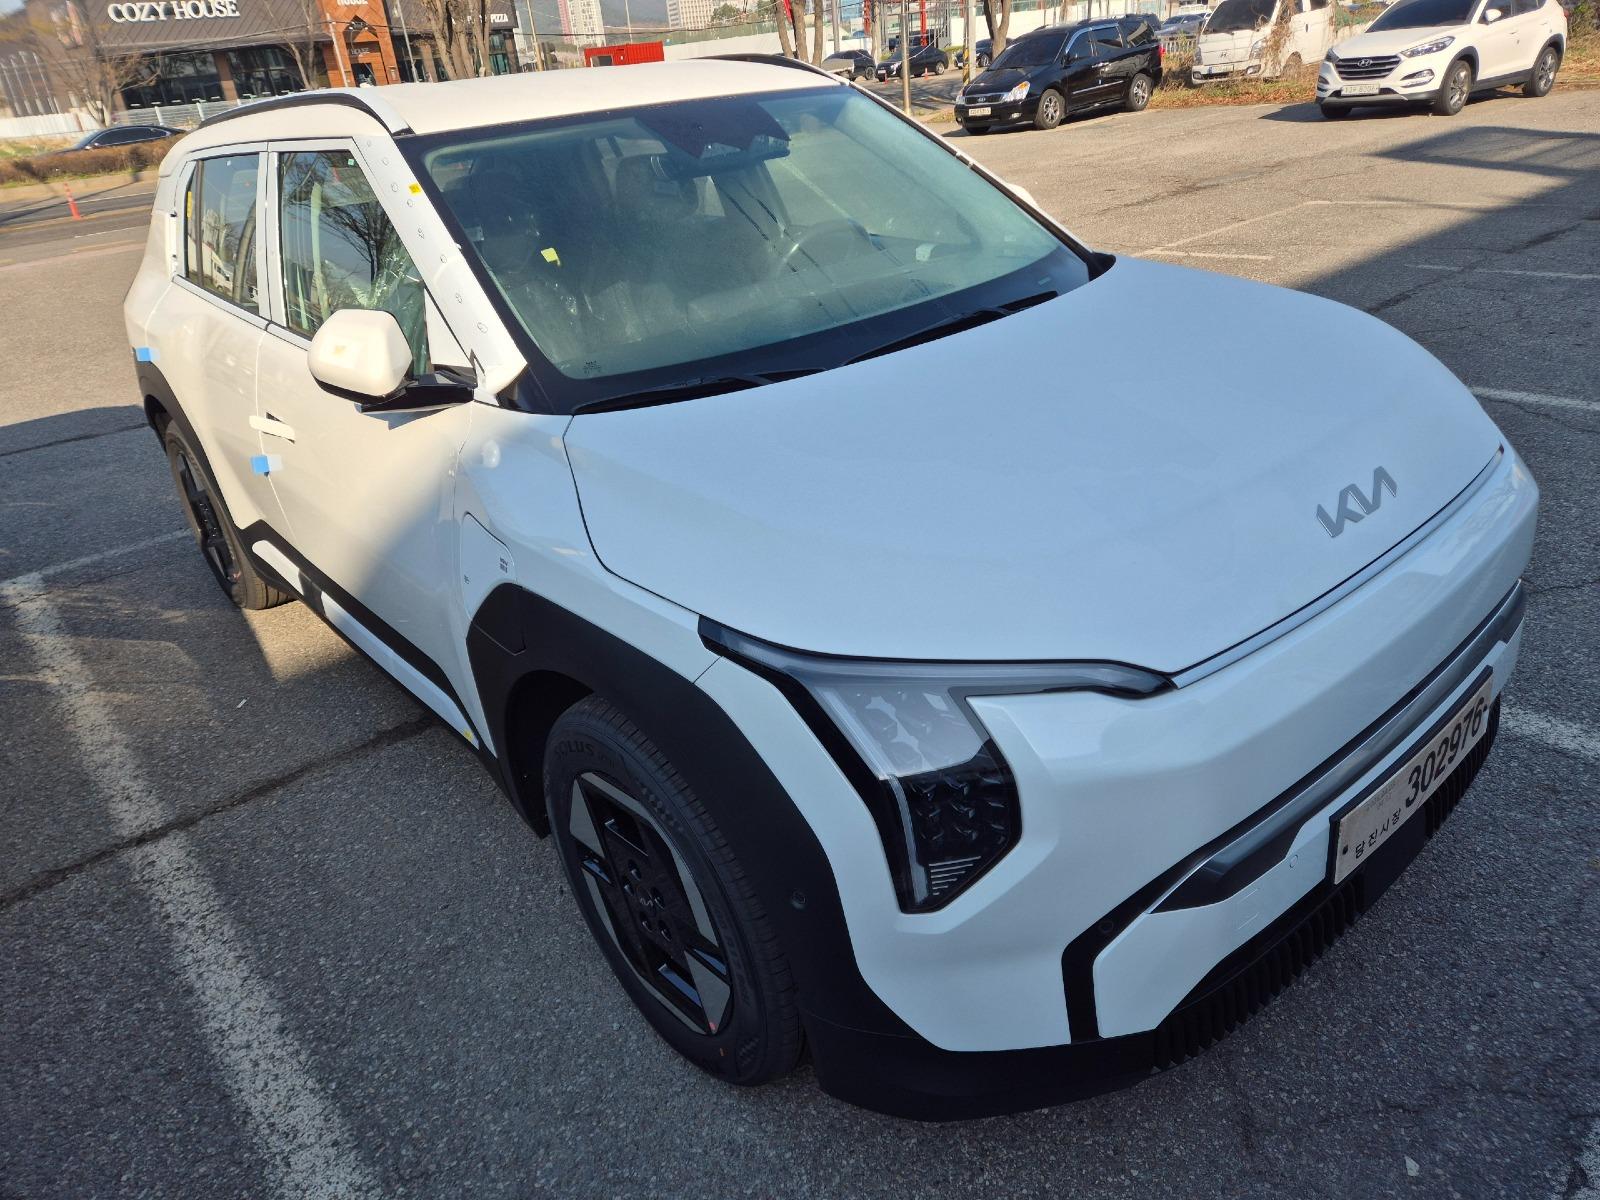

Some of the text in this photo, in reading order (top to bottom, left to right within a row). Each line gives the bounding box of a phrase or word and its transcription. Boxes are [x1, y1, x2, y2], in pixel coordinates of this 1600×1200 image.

[107, 0, 240, 22] COZY HOUSE
[490, 13, 509, 23] PIZZA
[1405, 696, 1487, 808] 302976
